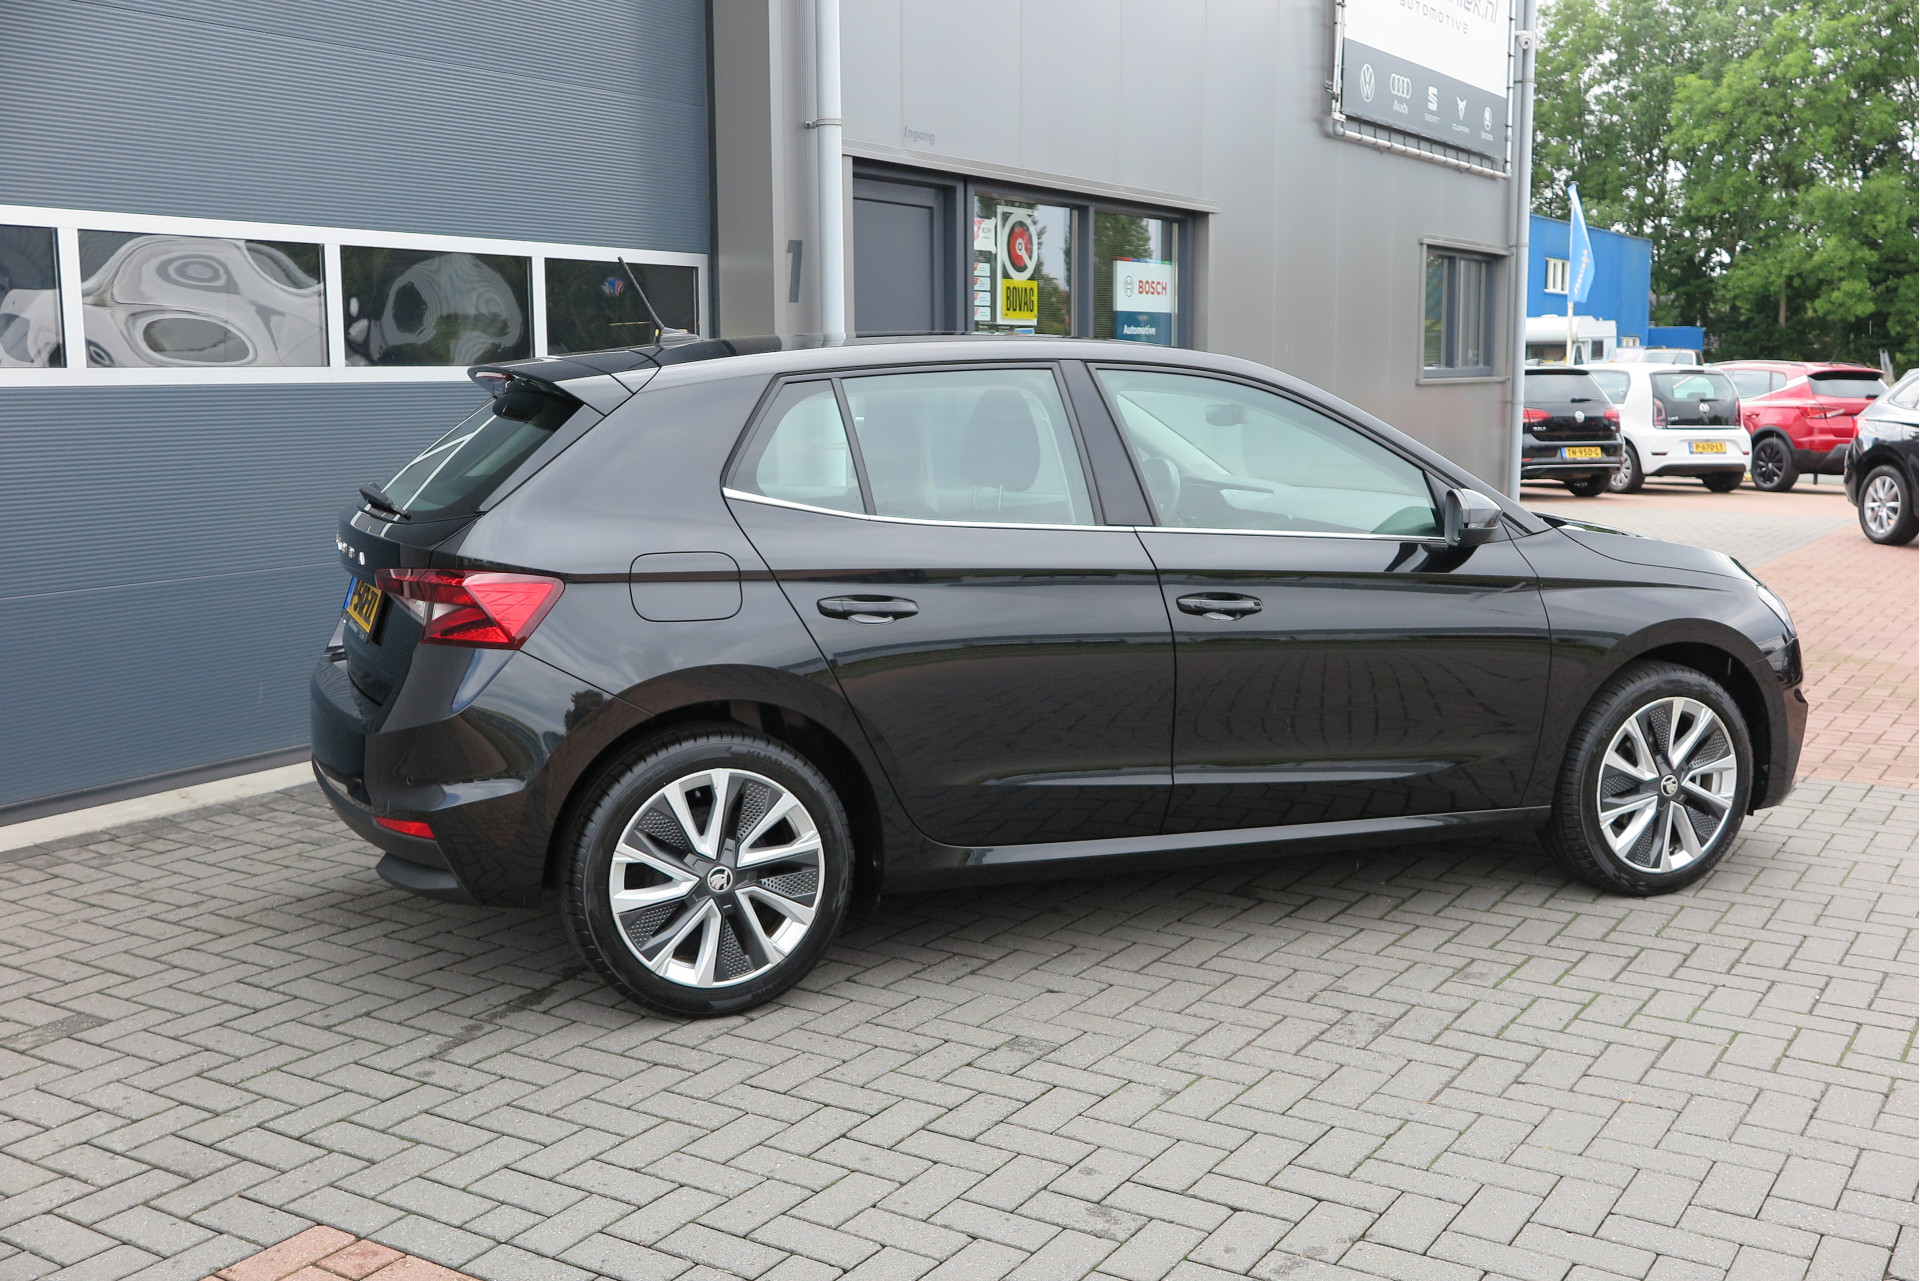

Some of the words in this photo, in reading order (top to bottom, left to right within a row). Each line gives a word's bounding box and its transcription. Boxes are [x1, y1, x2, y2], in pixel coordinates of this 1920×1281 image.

[1393, 100, 1409, 114] Audi
[904, 126, 935, 145] Ingang
[787, 240, 803, 303] 1
[1138, 280, 1167, 296] BOSCH
[1006, 286, 1034, 313] BOVAG
[1123, 324, 1156, 335] Automotive
[1567, 448, 1600, 457] TN-950-G
